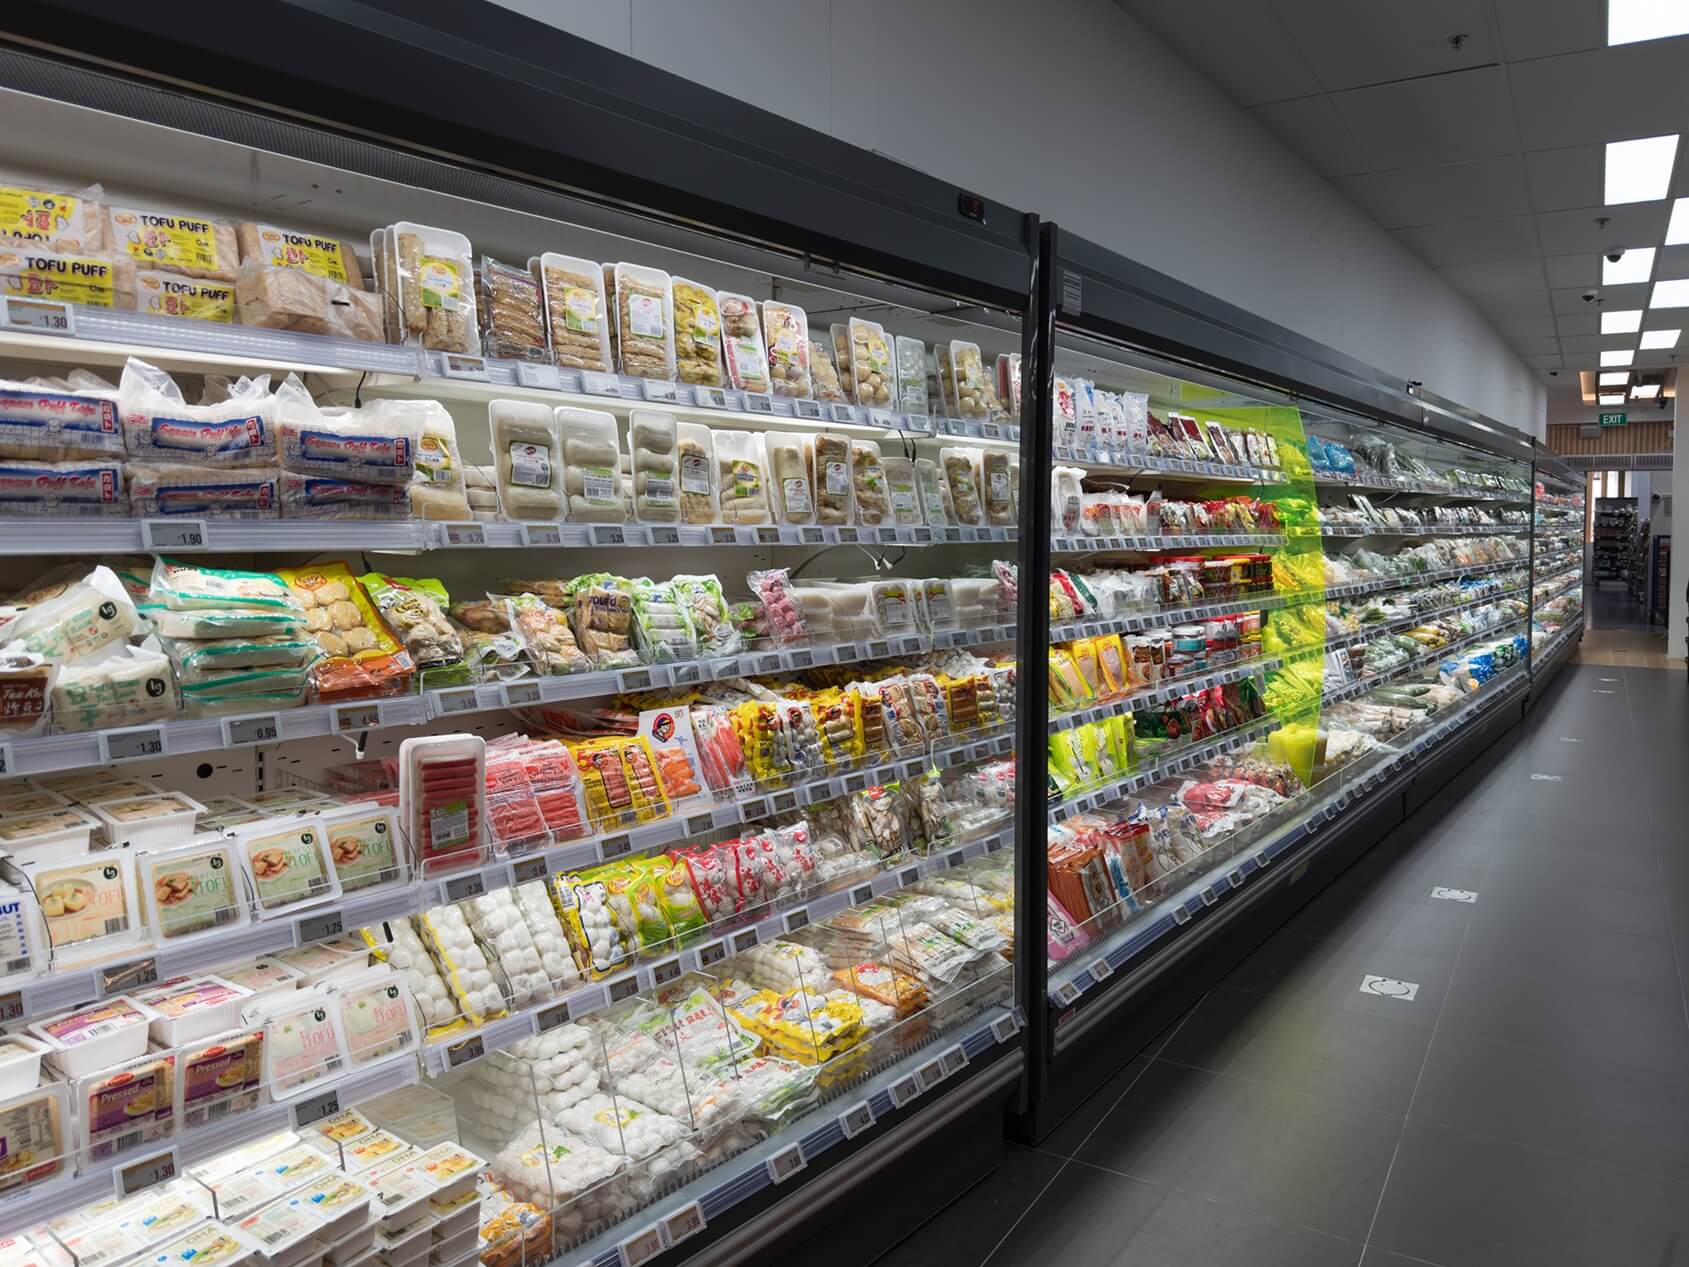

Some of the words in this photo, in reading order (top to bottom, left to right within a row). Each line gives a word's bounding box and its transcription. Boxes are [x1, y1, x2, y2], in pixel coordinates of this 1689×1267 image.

[140, 215, 175, 229] TOFU
[178, 220, 209, 233] PUFF
[282, 234, 312, 247] TOFU
[314, 239, 337, 253] PUFF
[25, 256, 66, 273] TOFU
[71, 262, 108, 277] PUFF
[163, 281, 197, 297] TOFU
[200, 287, 230, 301] PUFF
[43, 315, 68, 329] 1.30
[1603, 414, 1622, 425] EXIT
[181, 533, 203, 545] 1.90
[256, 727, 277, 739] 0.95
[139, 739, 162, 753] 1.30
[324, 921, 343, 936] 1.25
[195, 1055, 232, 1075] Pressed
[100, 1083, 142, 1105] Pressed
[153, 1162, 176, 1181] 1.30
[185, 1224, 218, 1245] DHA
